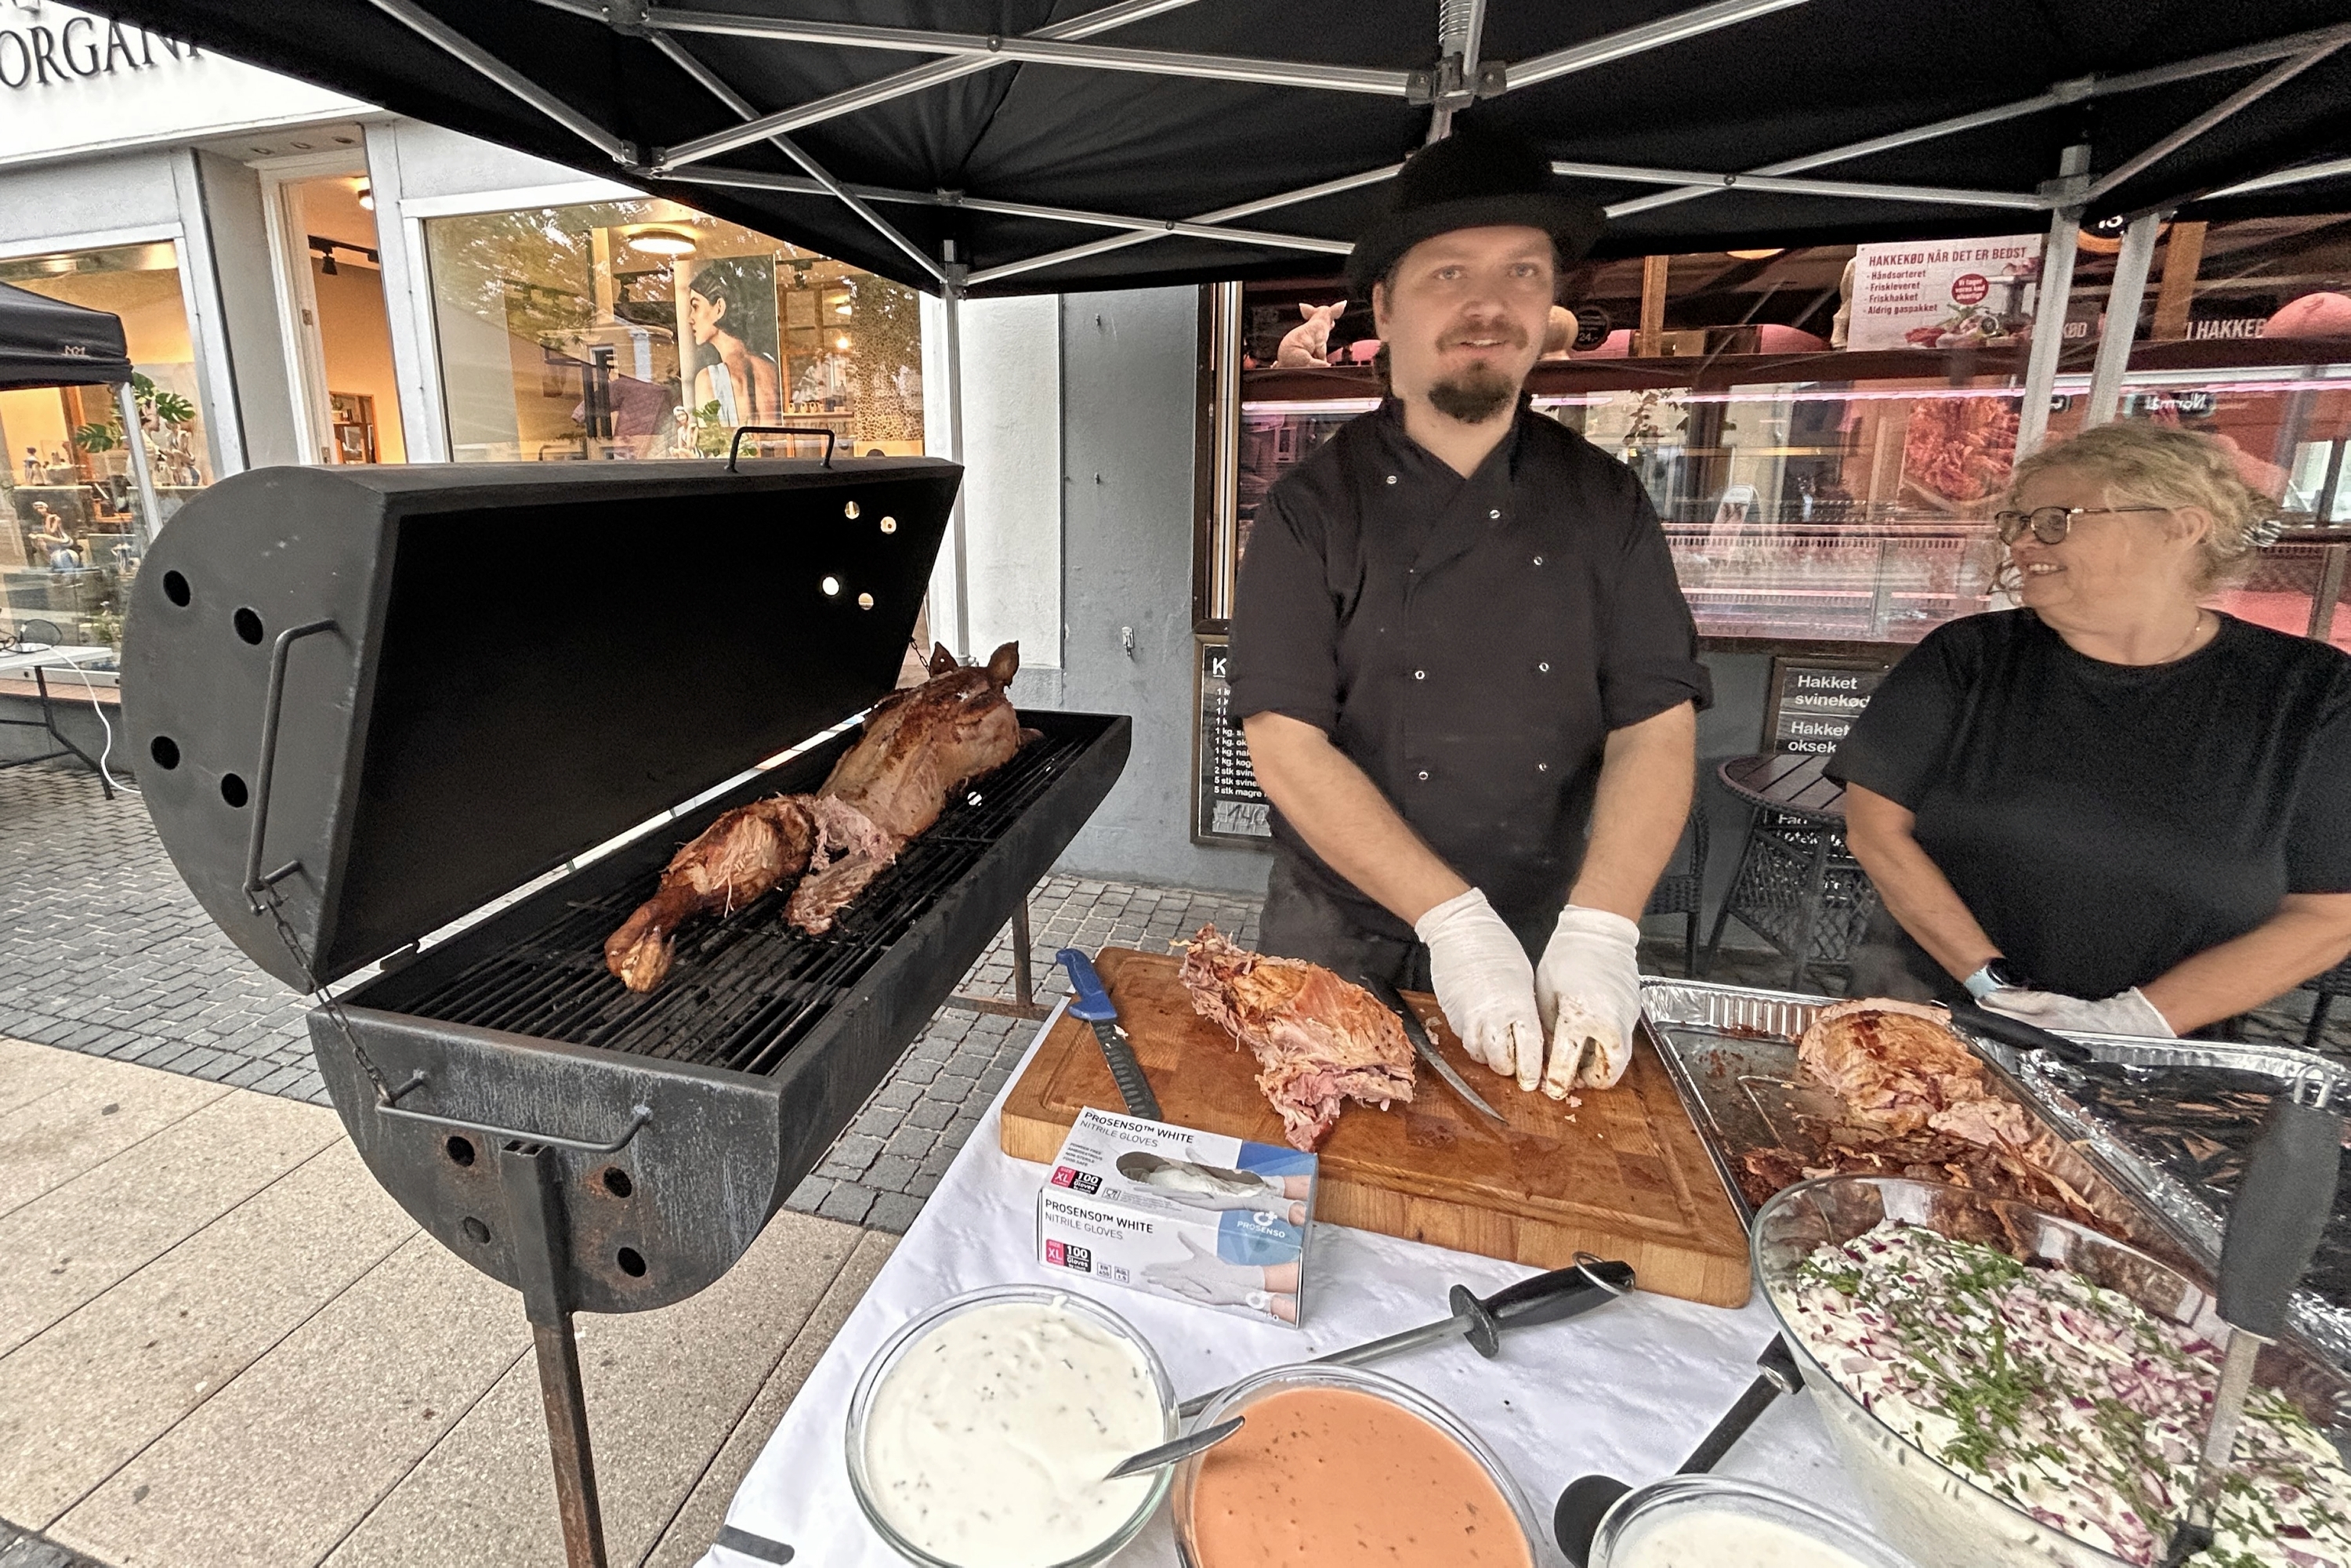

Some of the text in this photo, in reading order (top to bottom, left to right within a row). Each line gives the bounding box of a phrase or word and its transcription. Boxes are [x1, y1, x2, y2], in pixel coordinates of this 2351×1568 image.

[0, 16, 202, 88] ORGAN
[1869, 247, 2027, 266] HAKKEKØD NÅR DET ER BEDST
[1871, 270, 1926, 280] Håndsorteret
[1870, 281, 1921, 292] Friskleveret
[1869, 293, 1918, 303] Friskhakket
[1867, 303, 1938, 315] Aldrig gaspakket
[1798, 675, 1858, 690] Hakket
[1795, 693, 1871, 708] svinekød
[1222, 728, 1233, 737] kg.
[1791, 721, 1851, 737] Hakket
[1222, 737, 1233, 747] kg.
[1788, 739, 1837, 754] oksek
[1221, 748, 1233, 757] kg.
[1221, 757, 1233, 767] kg.
[1236, 759, 1253, 768] kog
[1214, 766, 1220, 775] 2
[1221, 767, 1233, 776] stk
[1235, 788, 1262, 798] magre
[1080, 1120, 1158, 1148] NITRILE GLOVES
[1157, 1128, 1194, 1144] WHITE
[1054, 1171, 1070, 1183] XL
[1078, 1172, 1099, 1184] 100
[1074, 1180, 1096, 1191] Gloves
[1045, 1211, 1124, 1240] NITRILE GLOVES
[1117, 1217, 1154, 1234] WHITE
[1237, 1220, 1286, 1238] PROSENSO
[1048, 1248, 1063, 1261] XL
[1067, 1245, 1089, 1259] 100
[1067, 1256, 1089, 1268] Gloves
